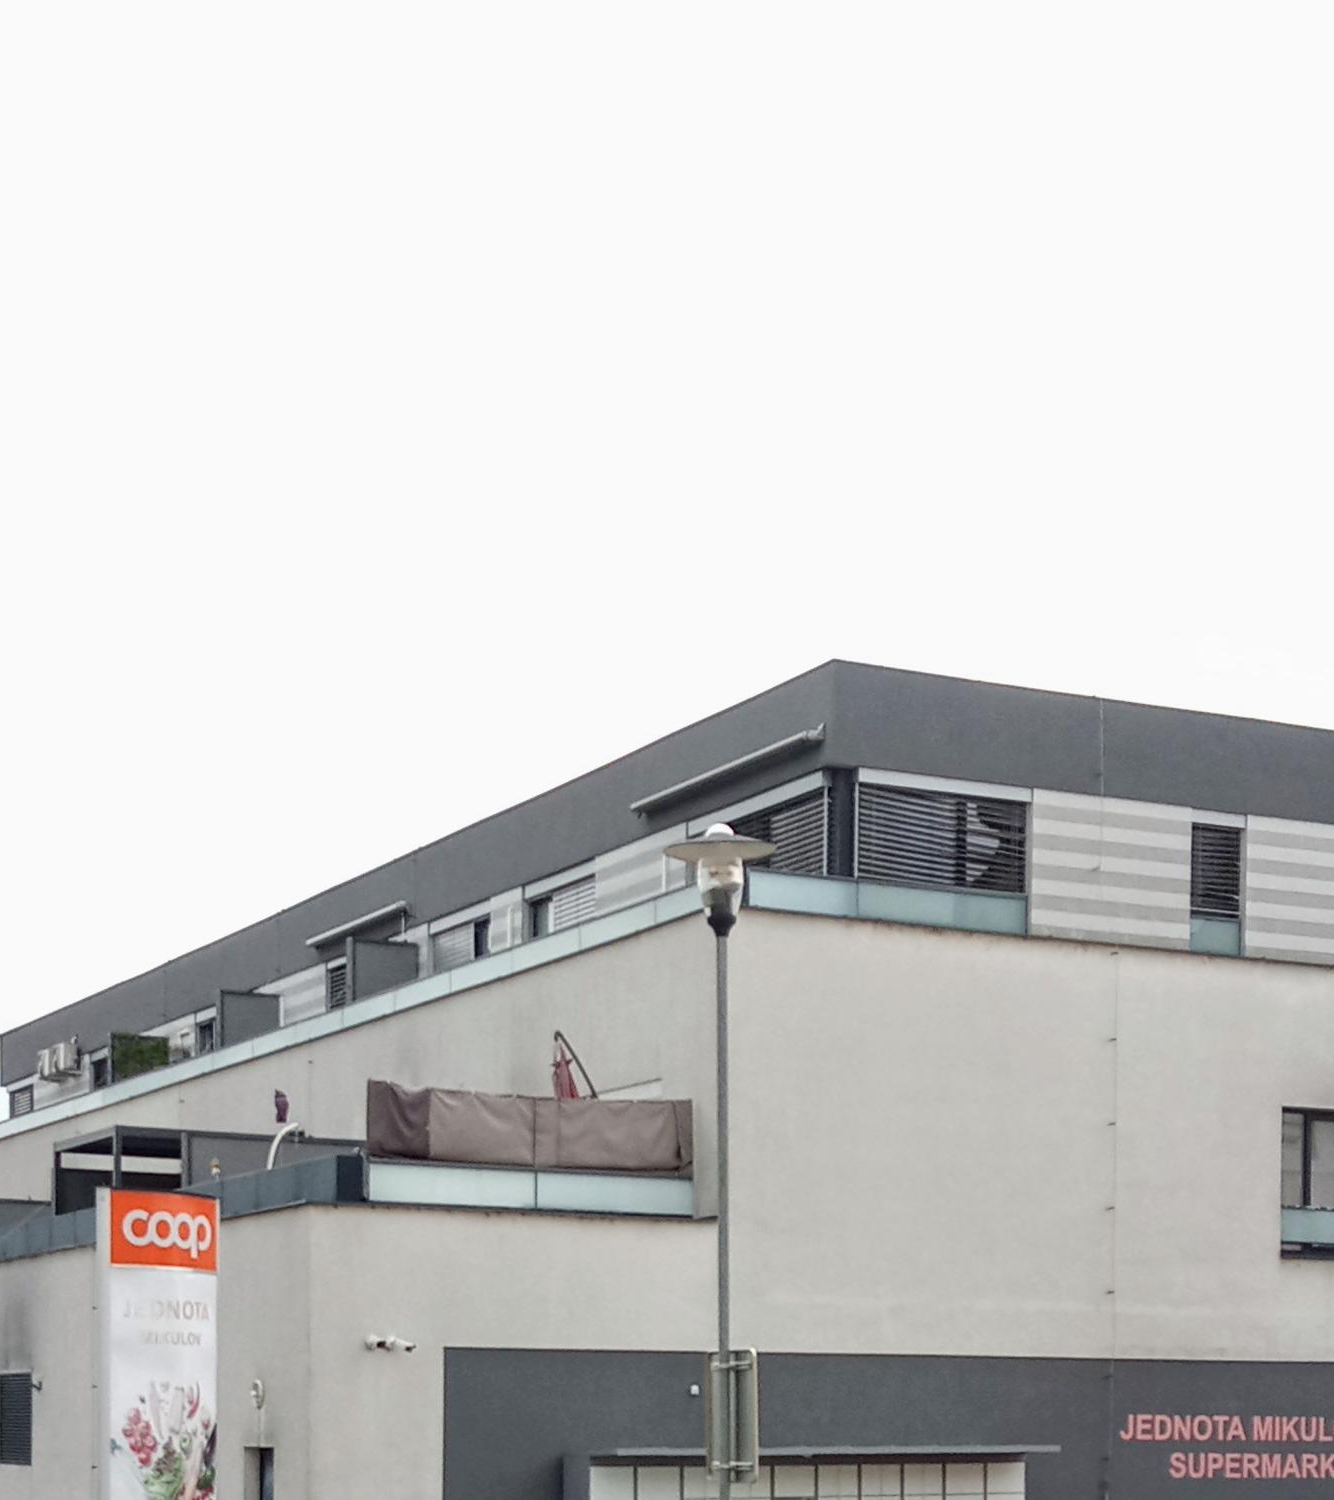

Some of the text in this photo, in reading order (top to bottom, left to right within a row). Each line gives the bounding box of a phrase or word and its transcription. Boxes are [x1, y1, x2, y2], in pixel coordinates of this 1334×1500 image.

[122, 1209, 212, 1259] coop
[122, 1299, 210, 1321] JEDNOTA
[1119, 1413, 1247, 1442] JEDNOTA
